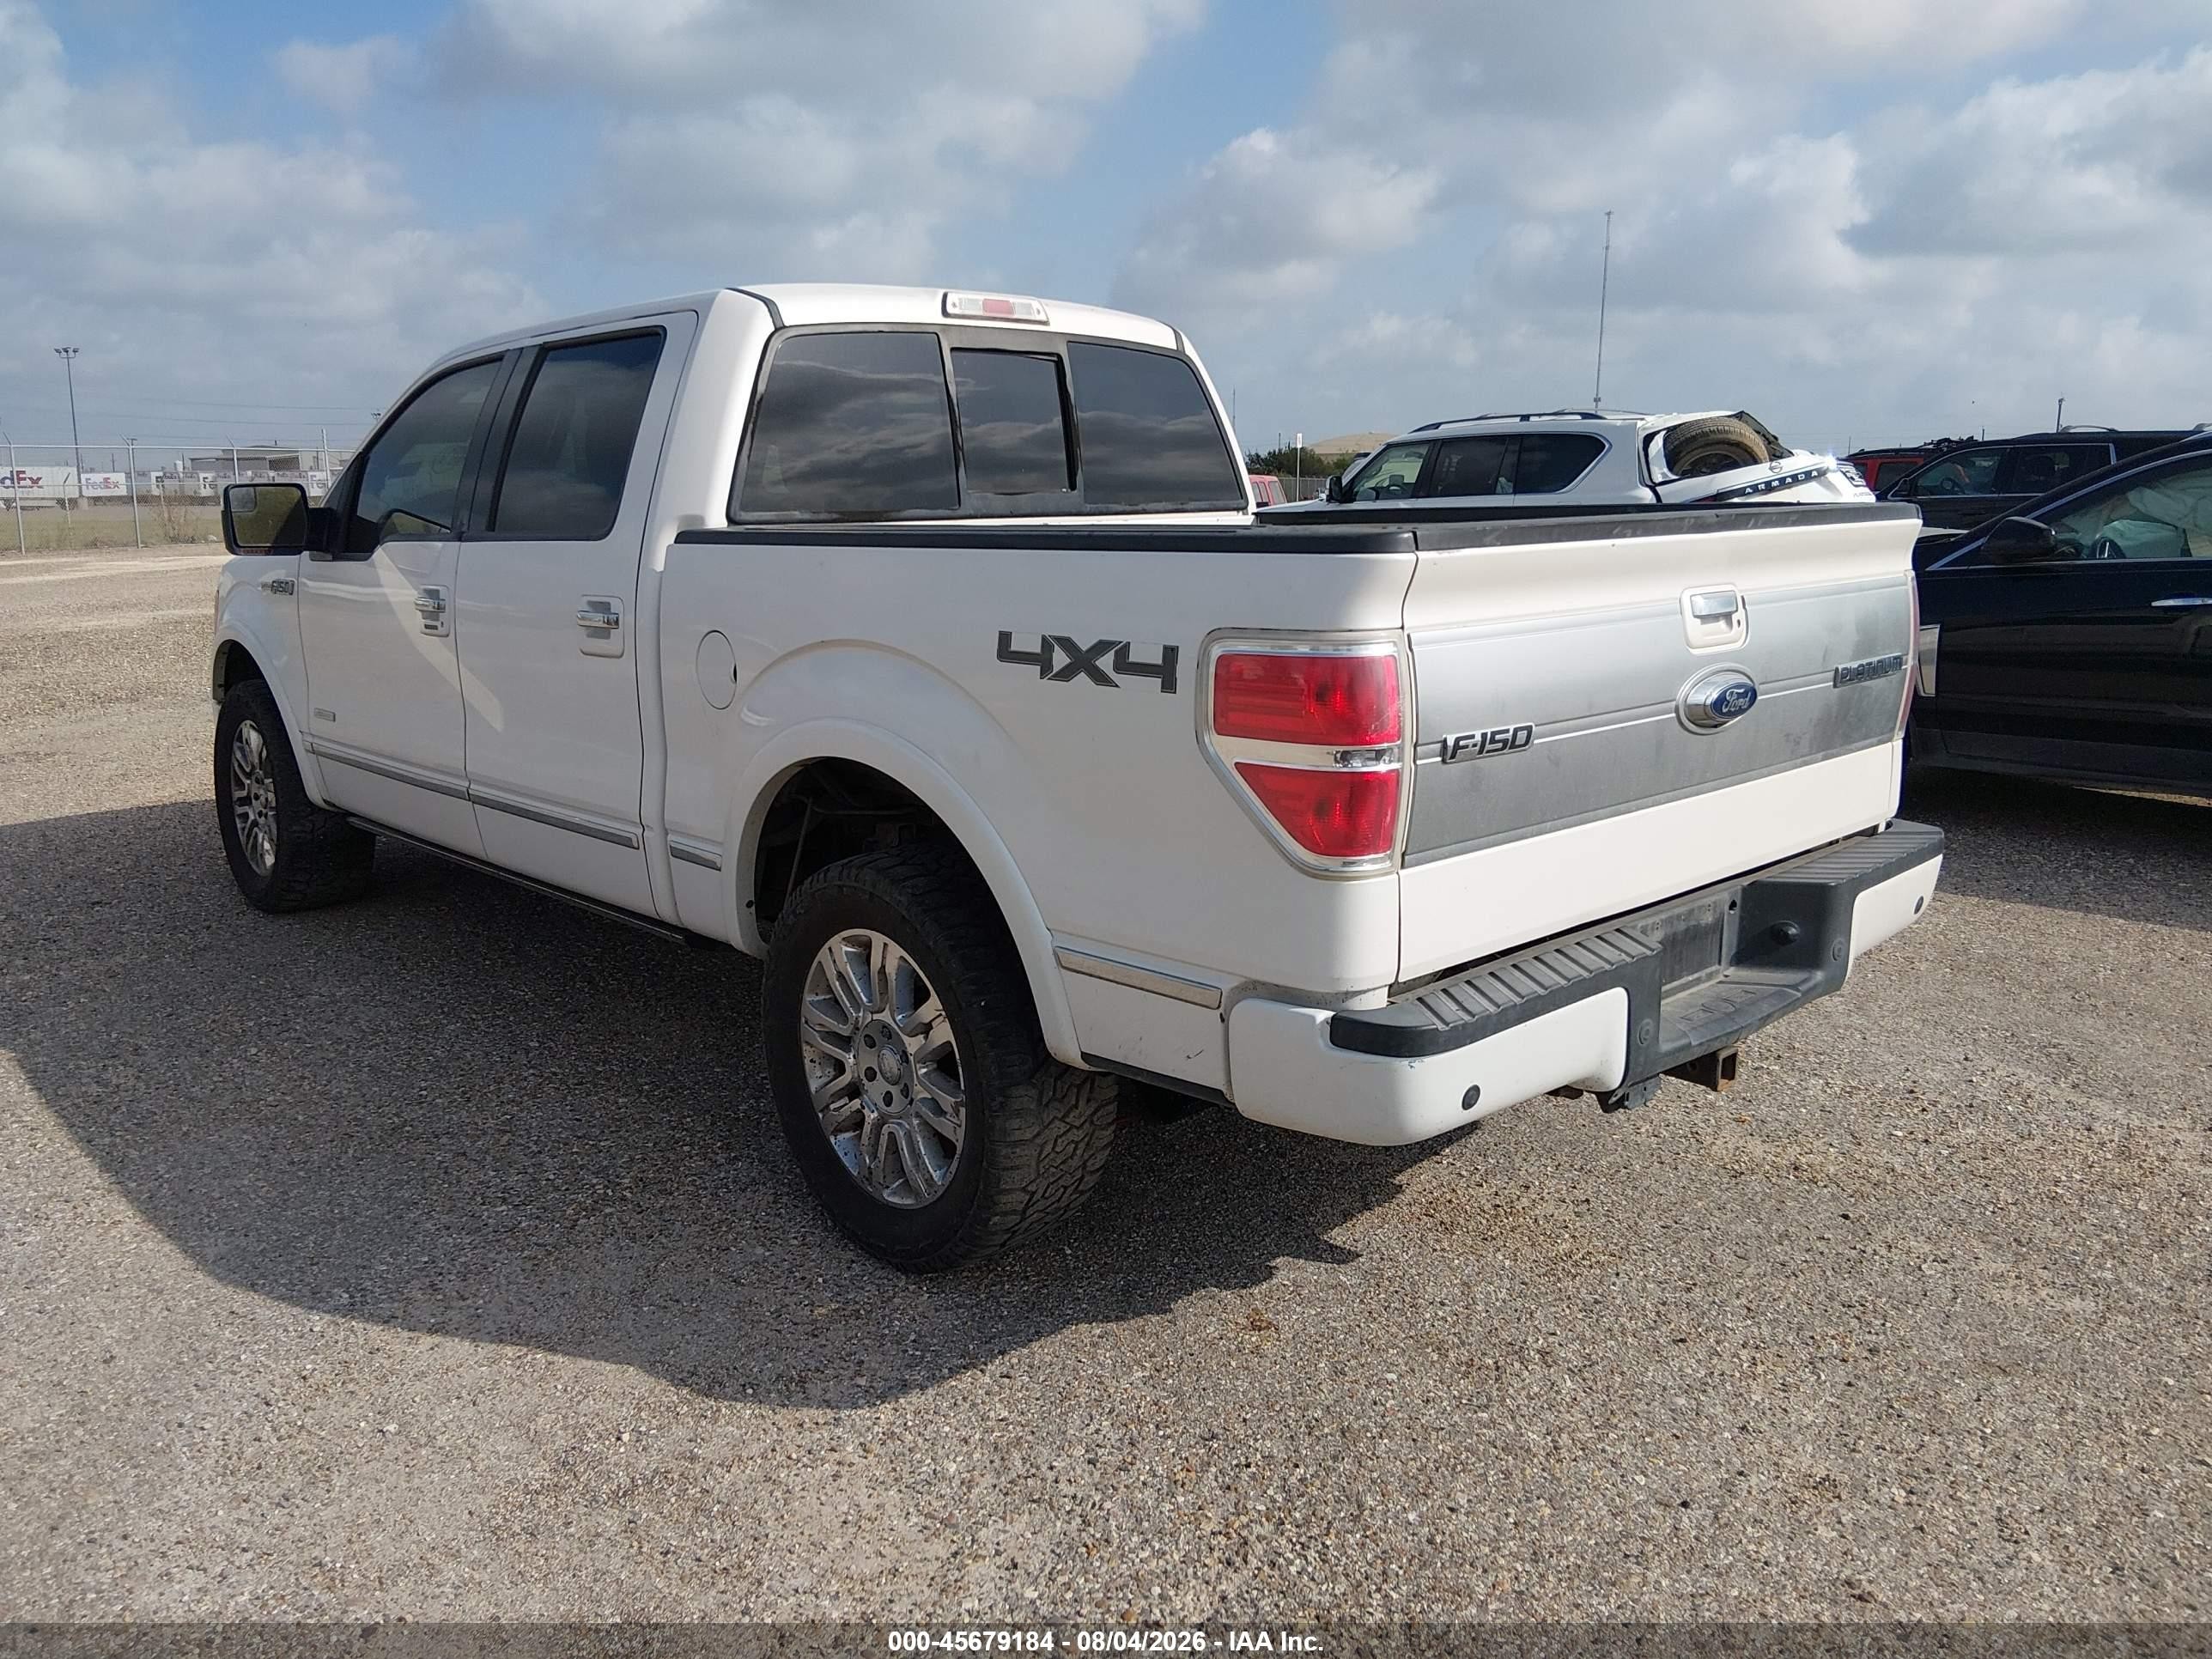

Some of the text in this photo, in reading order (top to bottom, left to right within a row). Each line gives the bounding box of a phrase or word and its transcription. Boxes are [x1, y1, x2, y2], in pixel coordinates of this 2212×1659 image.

[84, 477, 120, 490] FedEx
[1745, 471, 1819, 495] ARMADA
[1840, 655, 1904, 681] PLATINUM
[1722, 688, 1752, 713] Ford
[1448, 724, 1534, 761] F-150
